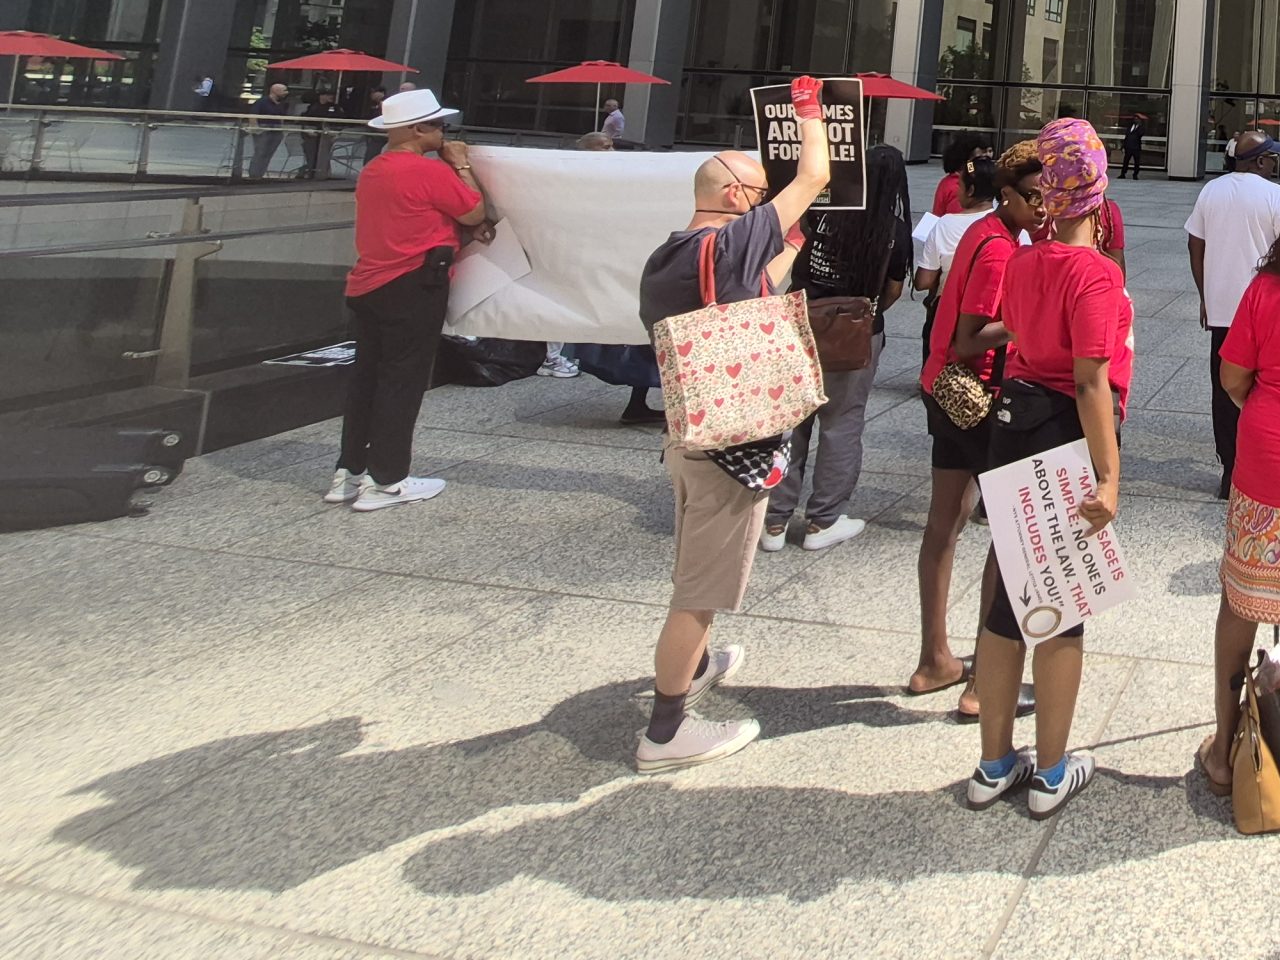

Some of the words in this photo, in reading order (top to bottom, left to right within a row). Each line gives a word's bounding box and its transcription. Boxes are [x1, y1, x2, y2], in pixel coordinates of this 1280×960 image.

[764, 104, 796, 119] OUR
[822, 105, 854, 120] MES
[769, 143, 801, 161] FOR
[830, 145, 855, 162] LE!
[1018, 486, 1048, 565] INCLUDES
[1032, 458, 1055, 512] ABOVE
[1046, 513, 1064, 545] THE
[1055, 546, 1076, 584] LAW.
[1069, 582, 1093, 618] THAT
[1056, 467, 1079, 528] SIMPLE:
[1072, 529, 1088, 552] NO
[1082, 552, 1101, 583] ONE
[1093, 582, 1106, 596] IS
[1097, 530, 1119, 568] SAGE
[1111, 567, 1125, 582] IS
